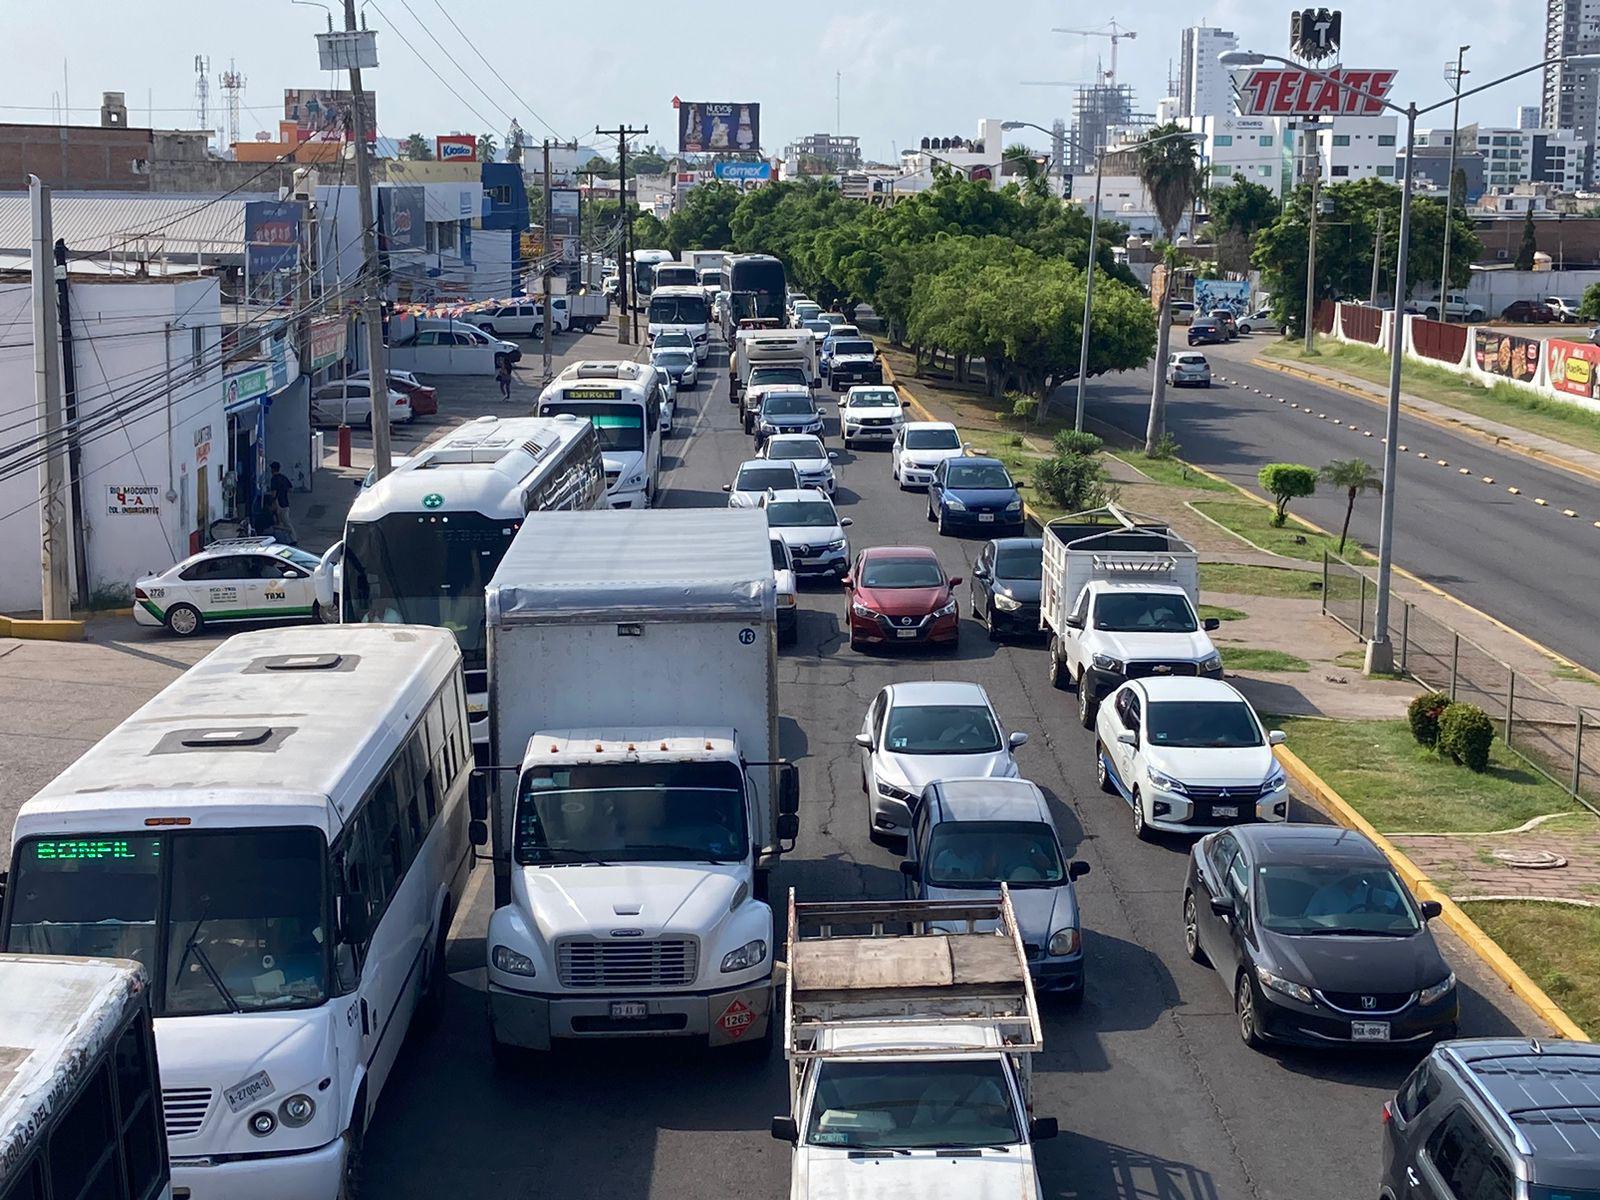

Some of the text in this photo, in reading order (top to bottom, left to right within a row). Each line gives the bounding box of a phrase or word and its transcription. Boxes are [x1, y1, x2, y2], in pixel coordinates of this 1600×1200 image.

[1250, 69, 1393, 112] TECATE
[706, 104, 733, 113] NUEVOS
[443, 145, 470, 157] Kiosko
[722, 165, 764, 177] Comex
[264, 591, 286, 601] TAXI
[740, 631, 754, 643] 13
[37, 841, 136, 859] BONFIL
[726, 1012, 751, 1027] 1263
[229, 1076, 270, 1105] A-27004-U
[1, 1119, 35, 1171] AGUILAS
[31, 1103, 48, 1131] DEL
